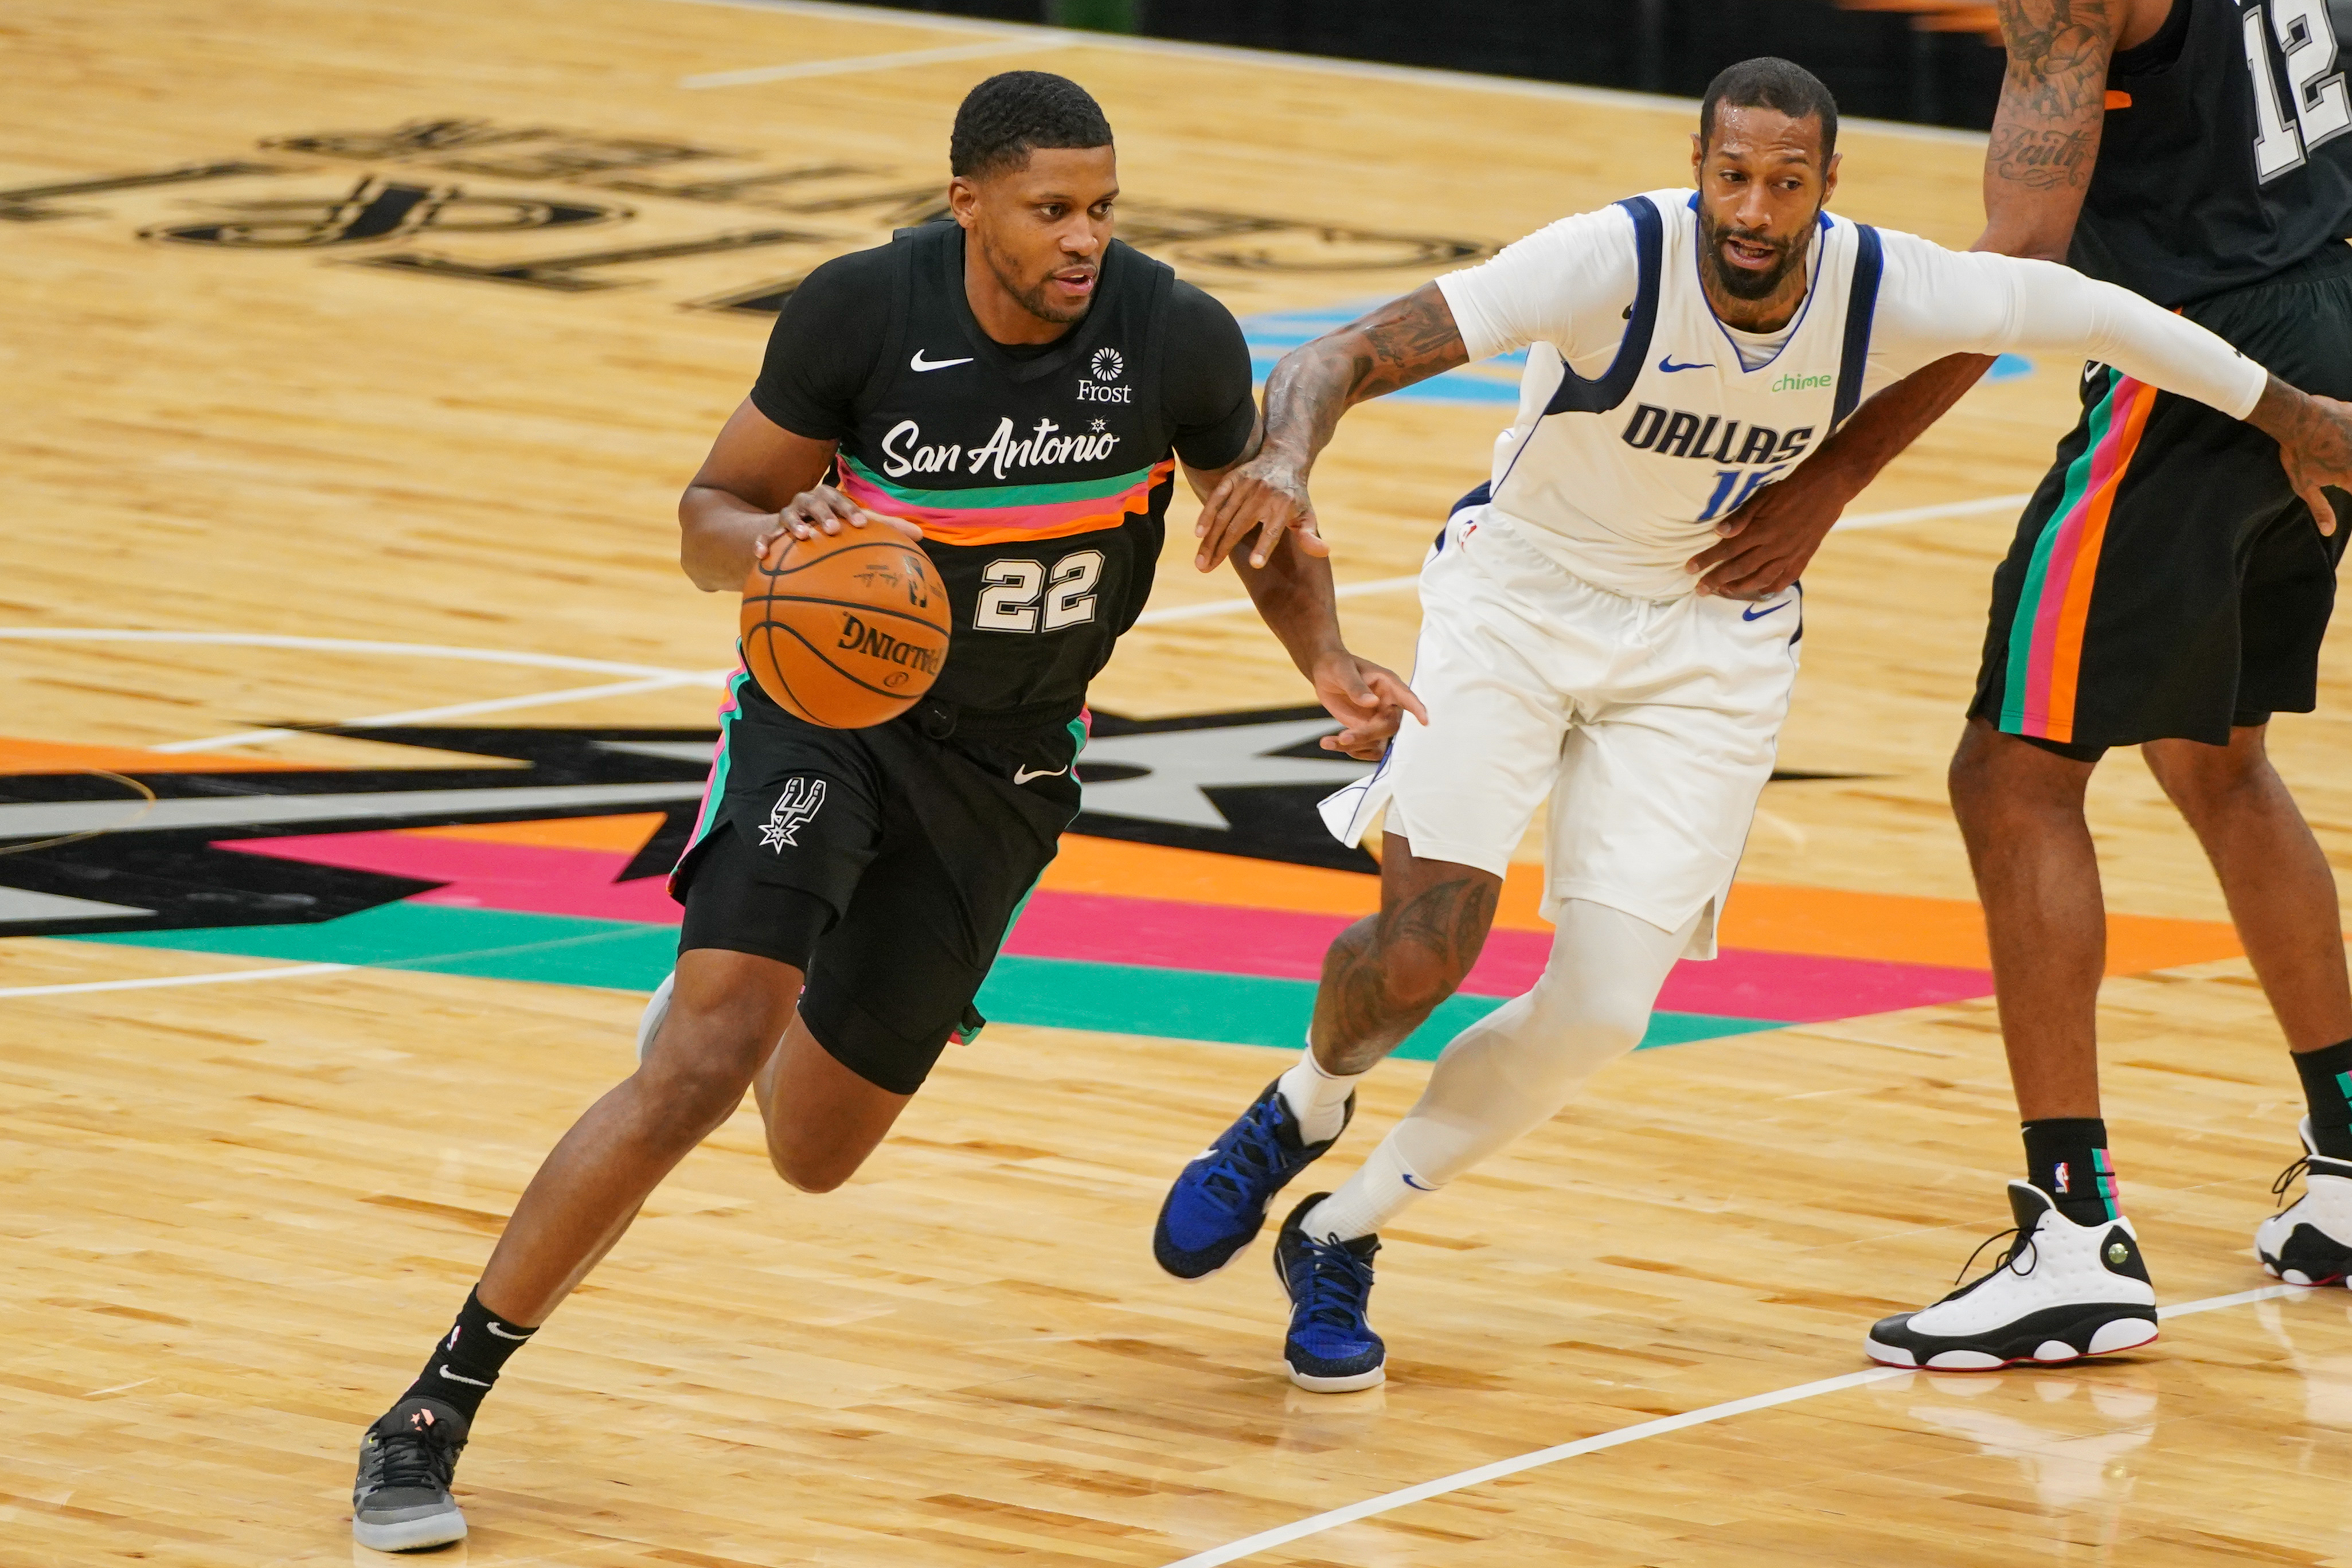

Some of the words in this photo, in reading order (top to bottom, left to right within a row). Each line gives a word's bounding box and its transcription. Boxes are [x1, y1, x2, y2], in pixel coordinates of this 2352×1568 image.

[2242, 0, 2352, 185] 12
[1990, 123, 2094, 185] Faith
[1077, 380, 1132, 403] Frost
[1772, 373, 1831, 393] chime
[881, 420, 962, 478] San
[967, 416, 1120, 480] Antonio
[1620, 403, 1815, 464] DALLAS
[974, 550, 1105, 633] 22
[838, 611, 943, 677] PALDING
